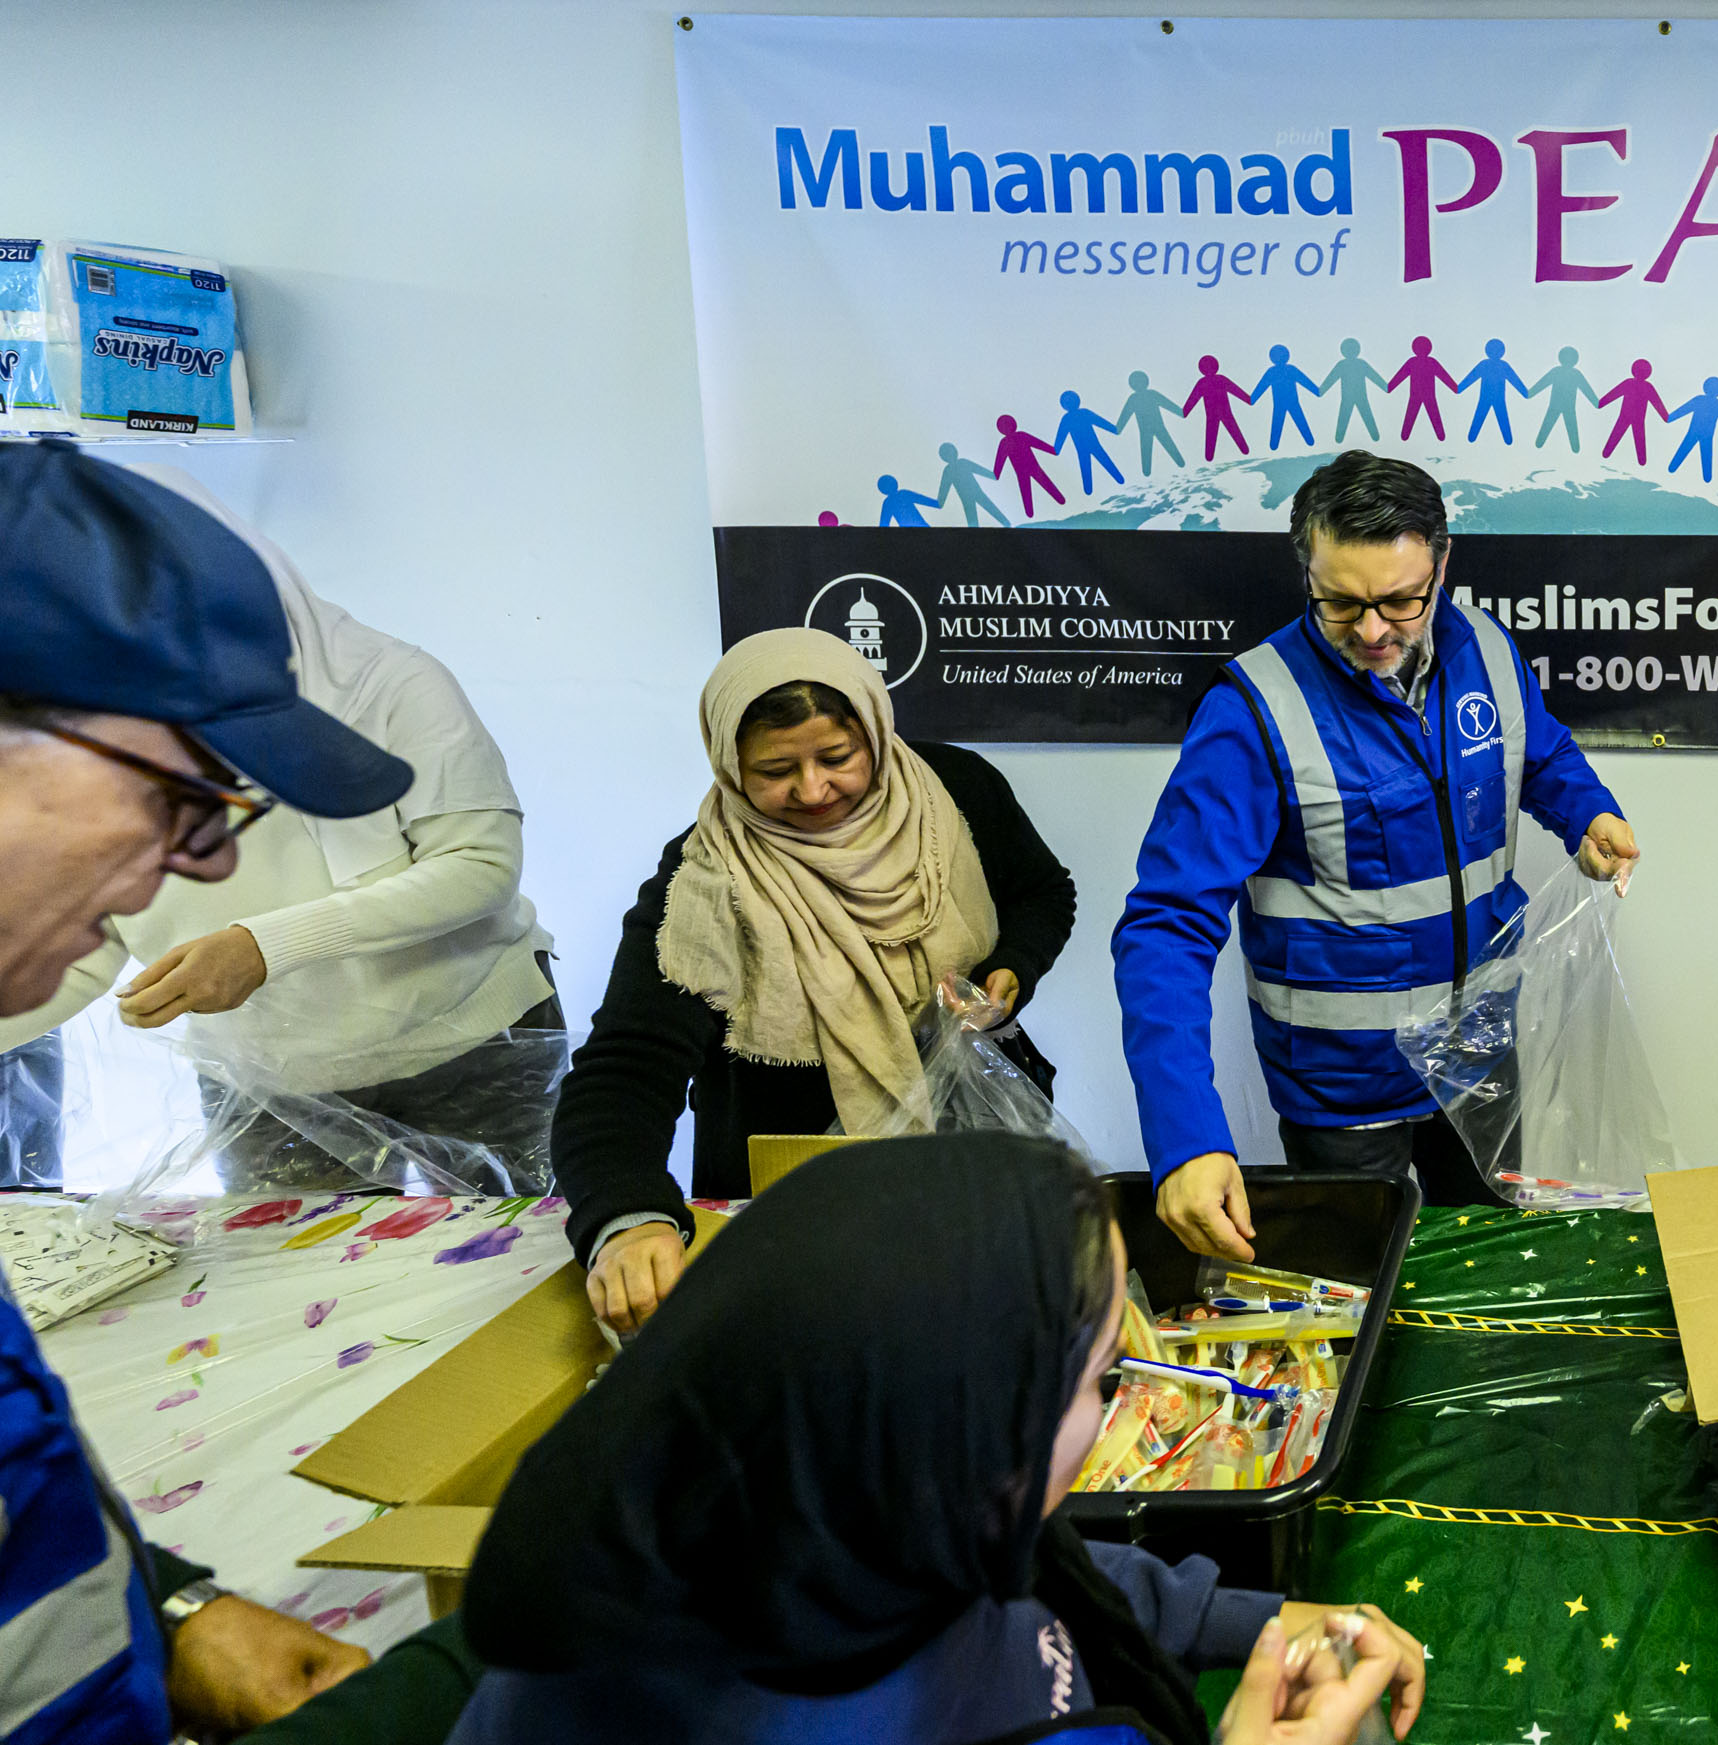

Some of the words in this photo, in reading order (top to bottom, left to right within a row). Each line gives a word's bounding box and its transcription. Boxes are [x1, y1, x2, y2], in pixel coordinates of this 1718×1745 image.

[776, 126, 1354, 217] Muhammad
[1001, 240, 1281, 289] messenger
[1295, 228, 1351, 277] of
[194, 279, 221, 291] 1120
[95, 335, 224, 376] Napkins
[130, 418, 195, 432] KIRKLAND
[938, 585, 1111, 608] AHMADIYYA
[939, 617, 1052, 639] MUSLIM
[1060, 617, 1235, 642] COMMUNITY
[942, 665, 1011, 685] United
[1014, 665, 1073, 685] States
[1078, 665, 1103, 689] of
[1101, 666, 1184, 686] America
